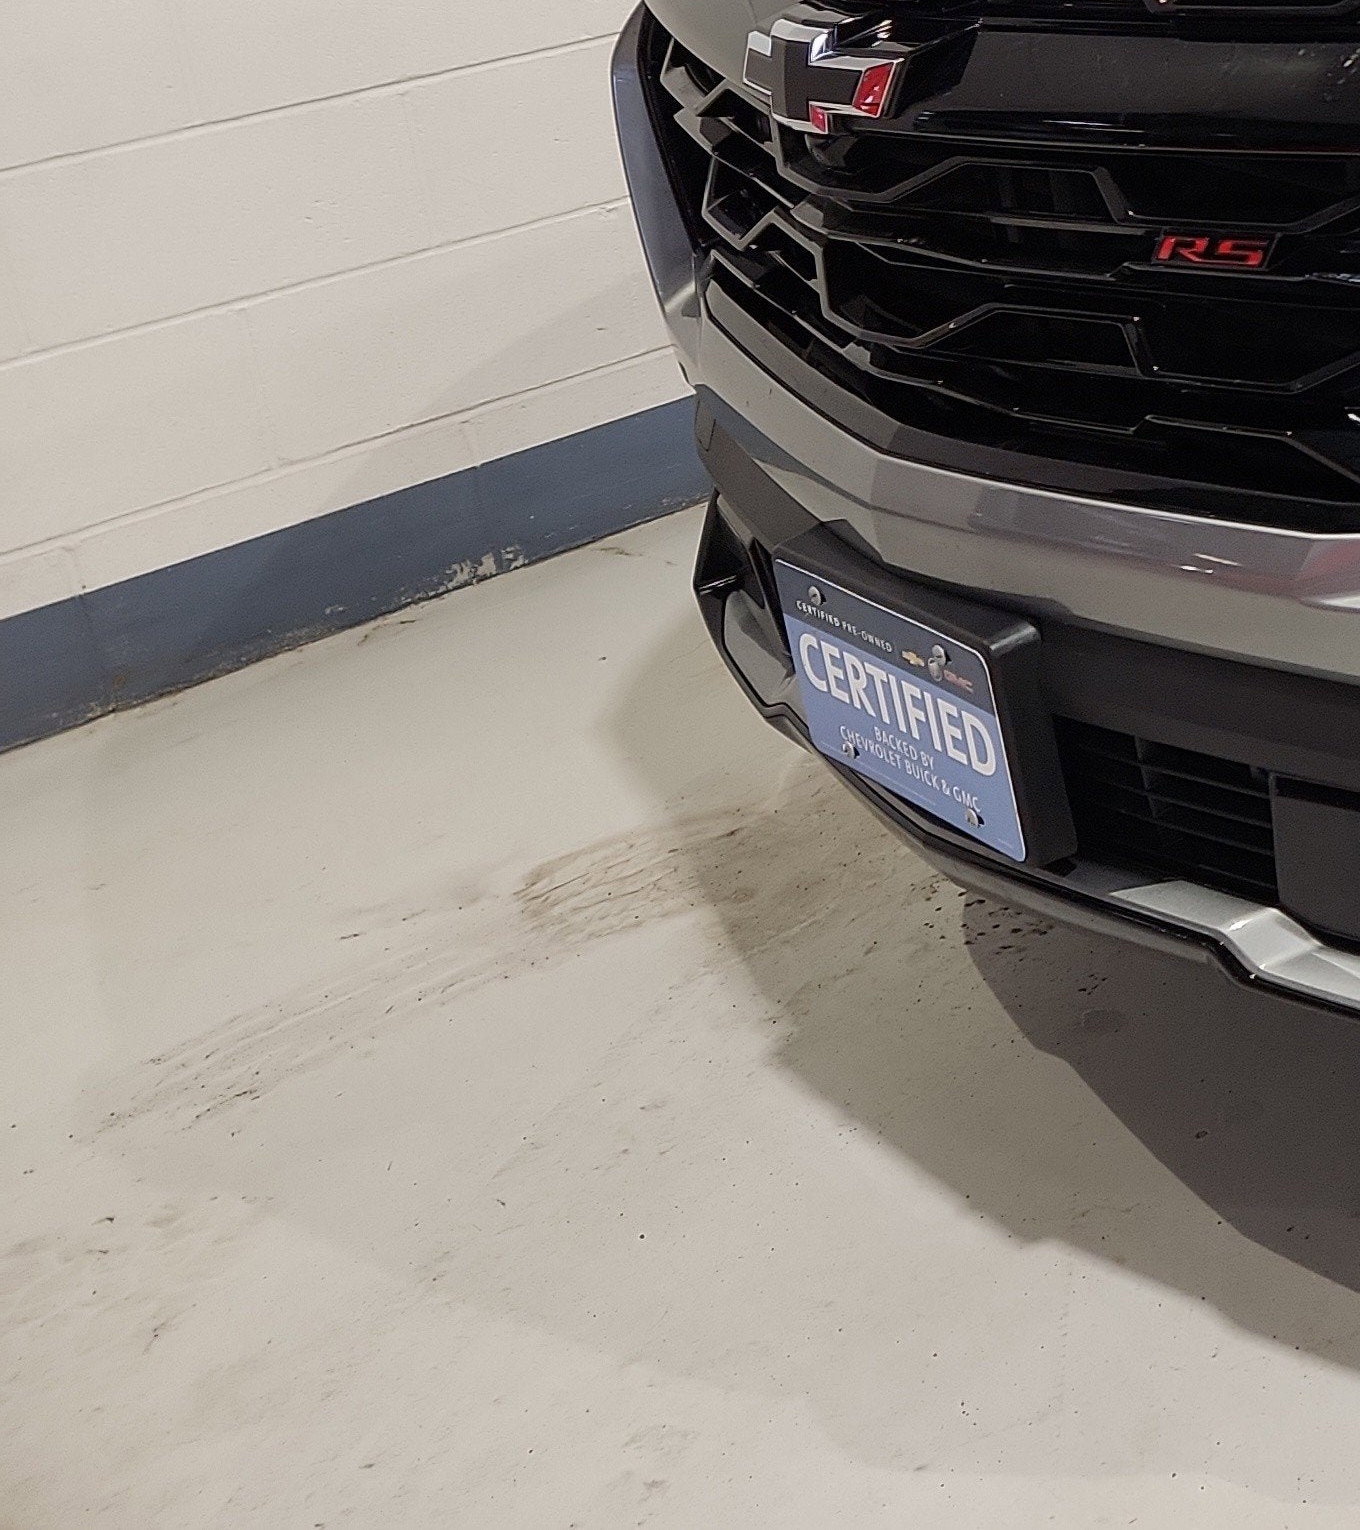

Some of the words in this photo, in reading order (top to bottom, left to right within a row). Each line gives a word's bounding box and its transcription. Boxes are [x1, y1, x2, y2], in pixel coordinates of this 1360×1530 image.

[1156, 235, 1268, 267] RS
[795, 599, 840, 628] CERTIFIED
[841, 621, 893, 653] PRE-OWNED
[799, 633, 996, 776] CERTIFIED
[840, 725, 902, 769] CHEVROLET
[905, 760, 940, 791] BUICK
[941, 779, 951, 796] &
[953, 786, 983, 812] GMC
[874, 726, 918, 761] BACKED
[920, 751, 934, 770] BY
